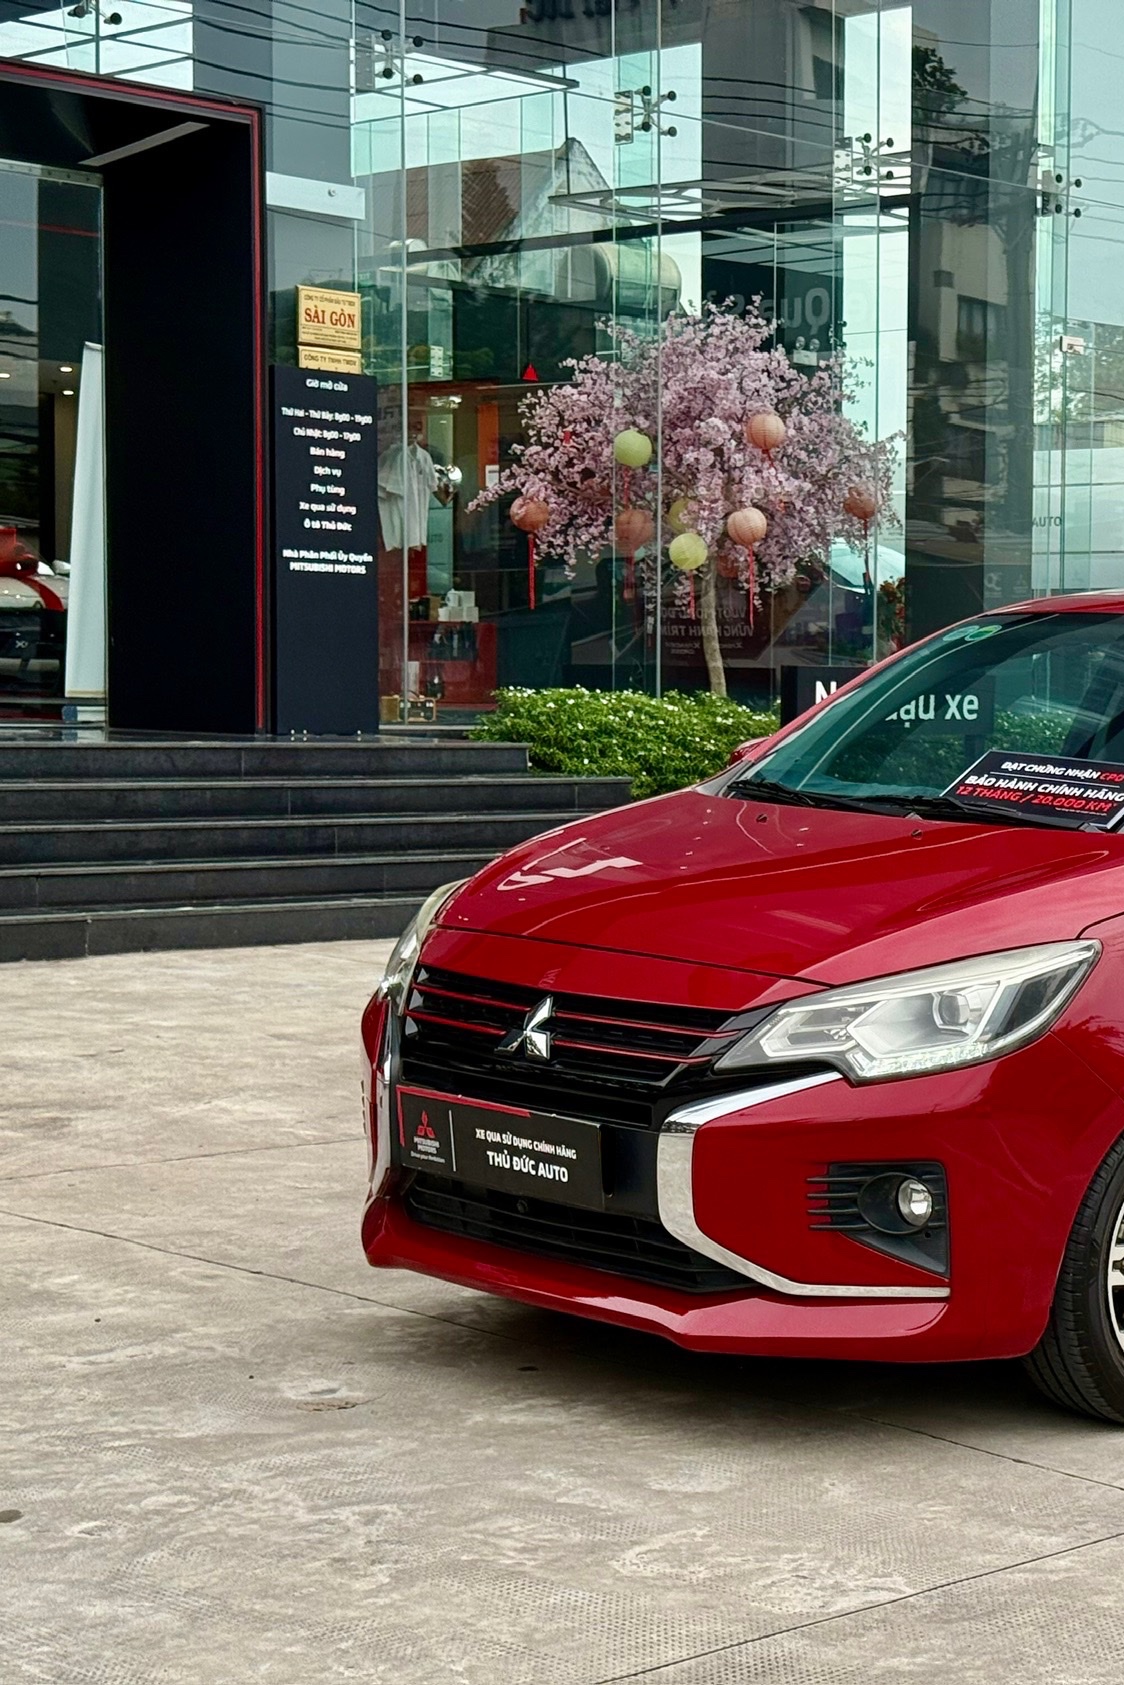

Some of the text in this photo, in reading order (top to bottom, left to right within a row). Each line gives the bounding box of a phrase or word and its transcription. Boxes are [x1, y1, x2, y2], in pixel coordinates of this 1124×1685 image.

[304, 304, 356, 328] SÀI GÒN
[320, 380, 333, 390] mở
[333, 381, 348, 392] cửa
[310, 446, 346, 459] Bán hàng
[313, 465, 342, 477] Dịch vụ
[310, 483, 346, 496] Phụ tùng
[299, 501, 357, 515] Xe qua sử dụng
[321, 520, 337, 530] Thủ
[337, 521, 353, 532] Đức
[289, 561, 367, 575] MITSUBISHI MOTORS
[944, 695, 979, 720] xe
[1001, 761, 1027, 772] ĐẠT
[1025, 762, 1066, 775] CHỨNG
[1065, 768, 1101, 780] NHẬN
[964, 774, 996, 787] BẢO
[995, 778, 1039, 792] HÀNH
[1037, 783, 1084, 797] CHÍNH
[956, 786, 974, 795] 12
[973, 786, 1022, 801] THÁNG
[1031, 795, 1086, 808] 20.000
[475, 1128, 577, 1160] XE QUA SỬ DỤNG CHÍNH HÃNG
[486, 1149, 568, 1183] THỦ ĐỨC AUTO
